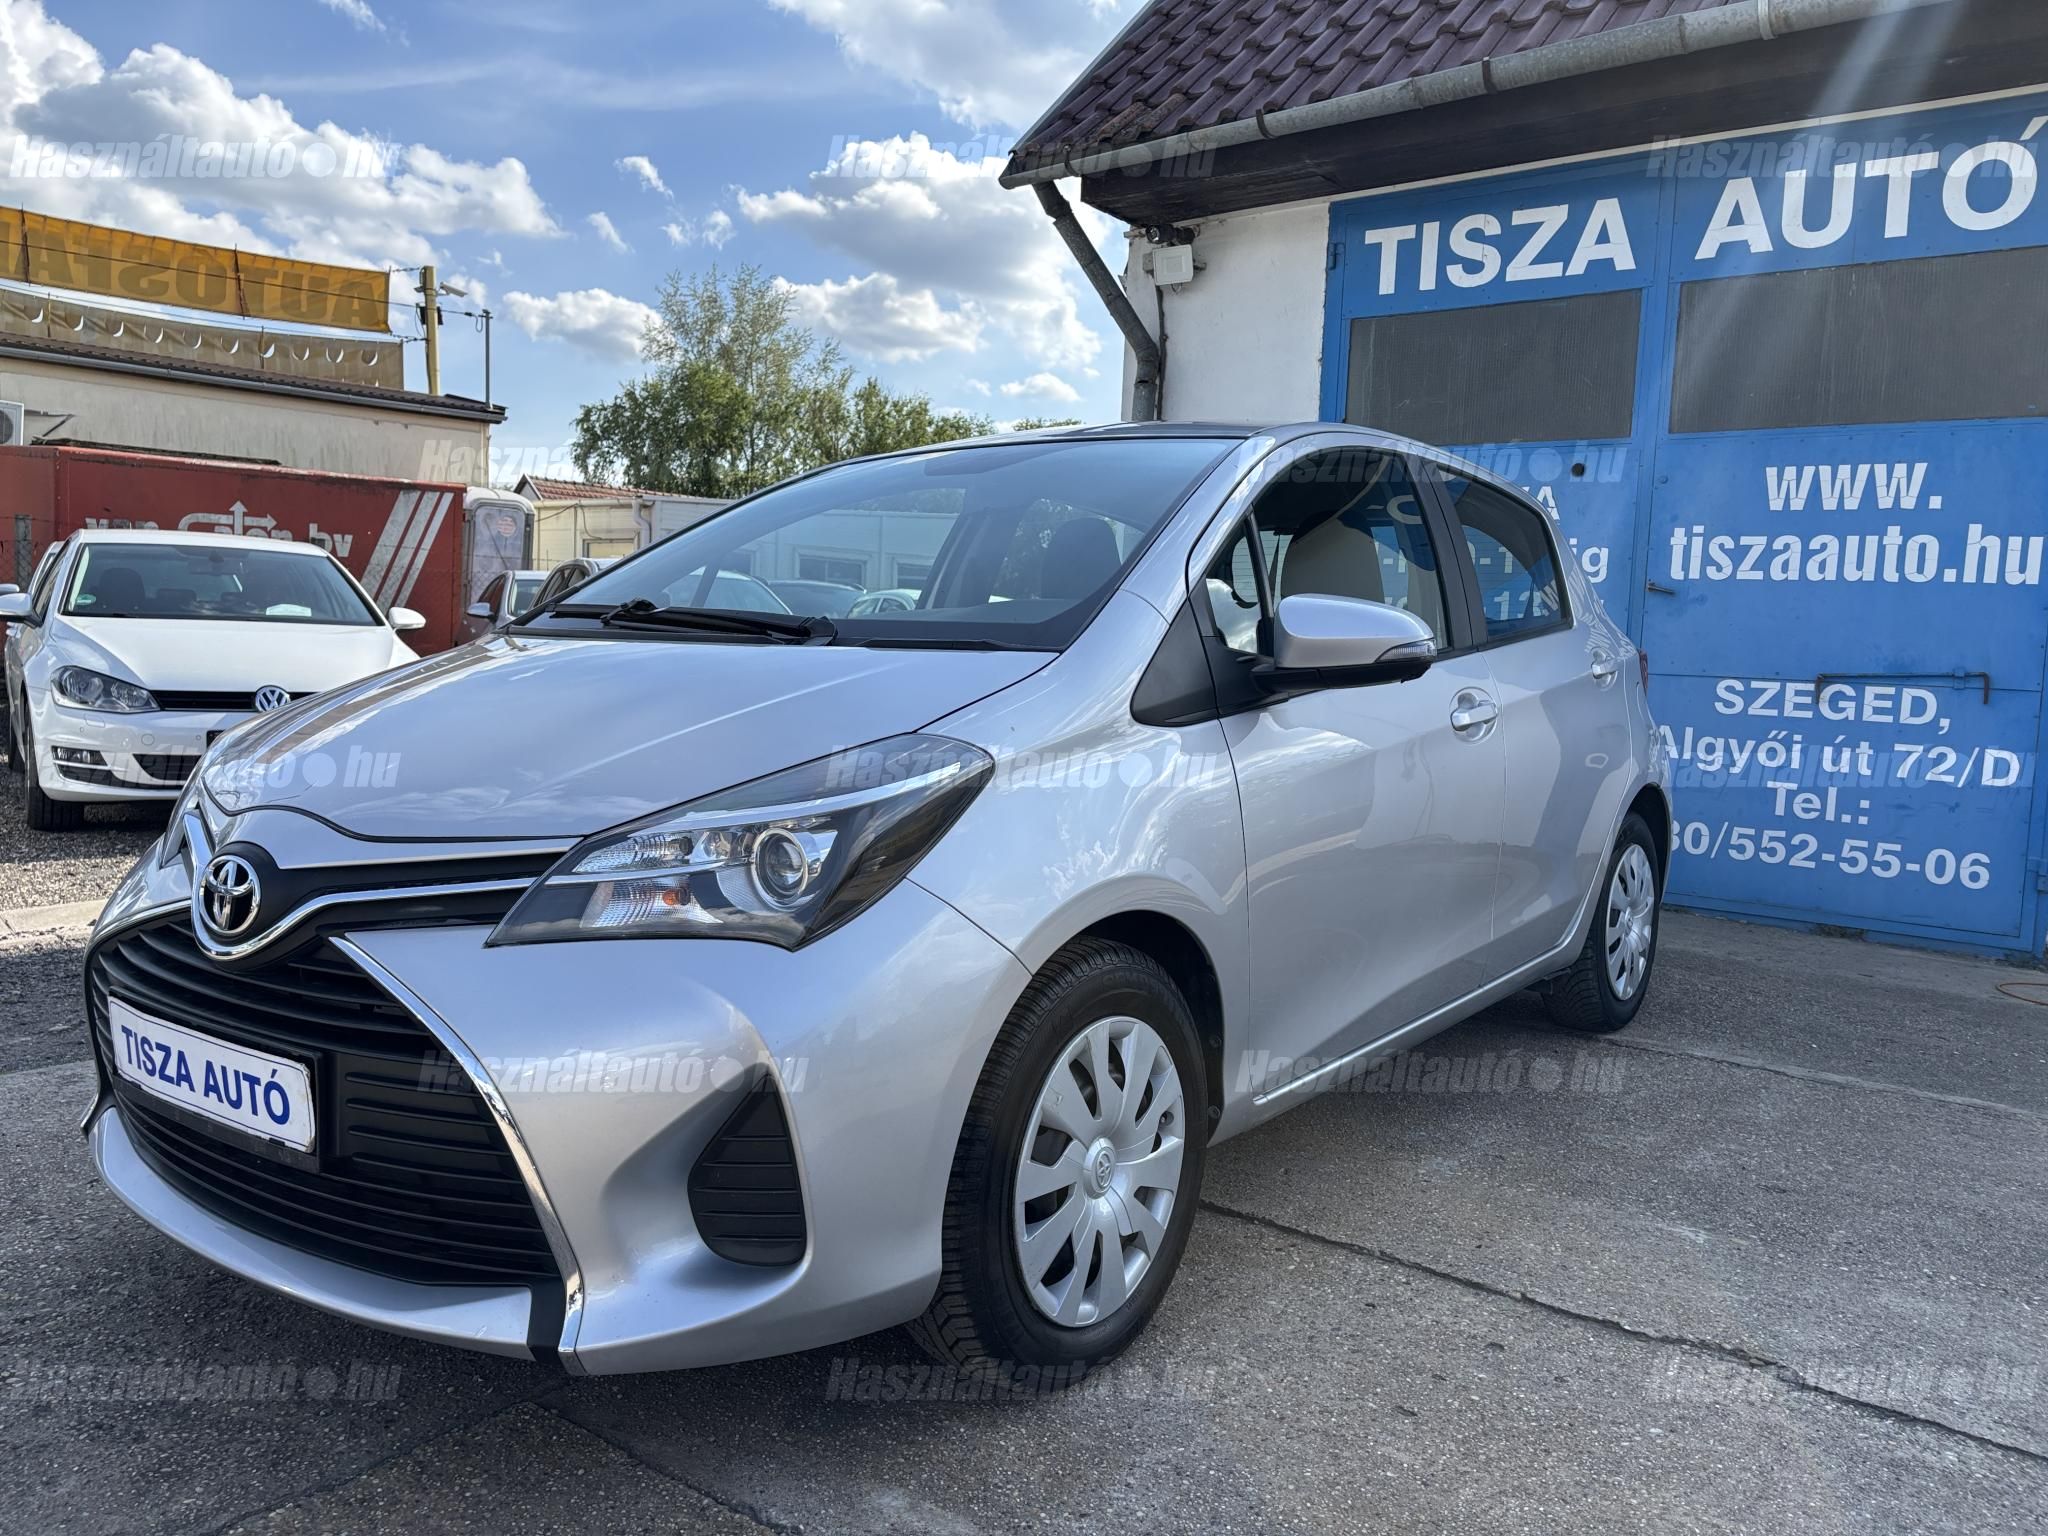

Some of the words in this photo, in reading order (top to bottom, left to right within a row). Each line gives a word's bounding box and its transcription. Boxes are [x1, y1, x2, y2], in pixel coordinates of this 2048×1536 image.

[1364, 197, 1637, 296] TISZA
[1694, 116, 2048, 261] AUTÓ
[1766, 462, 1943, 511] www.
[1670, 523, 2045, 586] tiszaauto.hu
[1713, 678, 1952, 736] SZEGED,
[1822, 735, 1874, 777] út
[1893, 743, 2022, 789] 72/D
[1766, 780, 1870, 825] Tel.:
[120, 1025, 196, 1093] TISZA
[203, 1060, 291, 1126] AUTÓ
